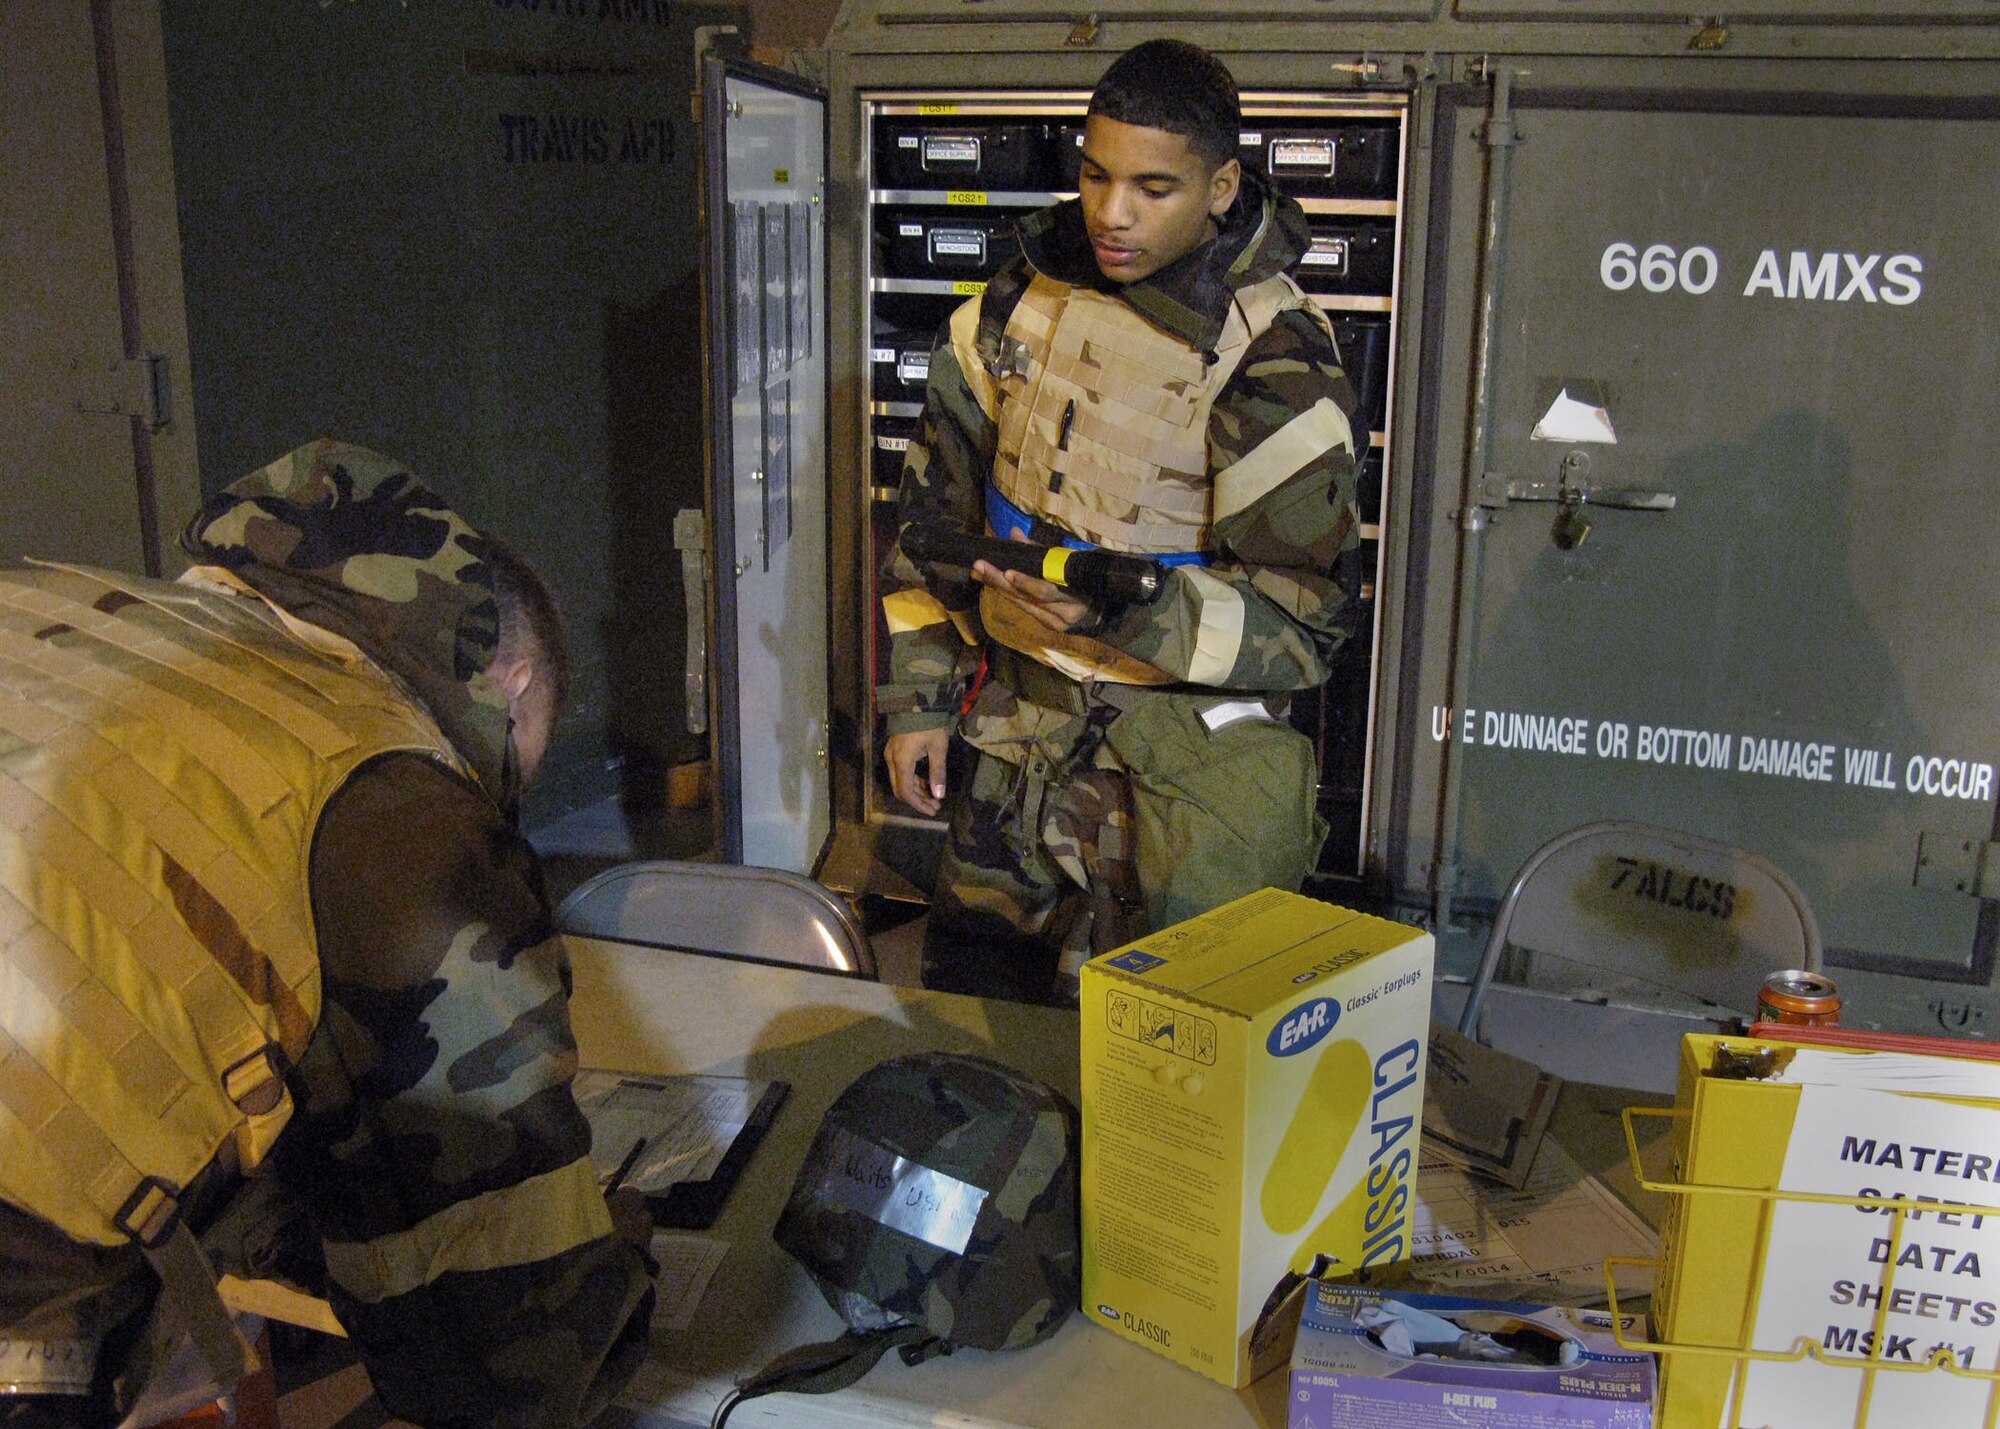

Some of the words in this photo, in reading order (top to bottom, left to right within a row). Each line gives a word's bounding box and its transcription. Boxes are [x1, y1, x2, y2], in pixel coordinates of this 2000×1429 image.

[498, 114, 609, 163] TRAVIS
[620, 117, 675, 164] AFB
[899, 138, 909, 146] BIN
[927, 150, 947, 158] OFFICE
[1275, 154, 1299, 162] OFFICE
[957, 193, 977, 203] CS2
[939, 244, 977, 252] BENCHSTOCK
[1600, 242, 1719, 295] 660
[1743, 249, 1924, 306] AMXS
[963, 284, 983, 293] CS3
[881, 351, 892, 360] #7
[878, 437, 892, 448] BIN
[1484, 711, 1588, 755] DUNNAGE
[1596, 721, 1629, 759] OR
[1637, 726, 1732, 770] BOTTOM
[1738, 736, 1834, 782] DAMAGE
[1844, 748, 1896, 790] WILL
[1906, 756, 1993, 801] OCCUR
[1312, 948, 1370, 973] CLASSIC
[1383, 968, 1422, 996] Earplugs
[1359, 1037, 1420, 1284] CLASSIC
[1498, 1217, 1531, 1229] 015
[1868, 1237, 1982, 1278] DATA
[1317, 1293, 1351, 1306] PLUS
[1829, 1279, 1997, 1327] SHEETS
[1123, 1311, 1172, 1348] CLASSIC
[1823, 1325, 1917, 1361] MSK
[1301, 1356, 1336, 1369] 8005L
[1297, 1375, 1311, 1383] REF
[1312, 1375, 1340, 1388] 8005L
[1559, 1375, 1594, 1389] PLUS
[1597, 1381, 1641, 1393] N-DEX
[1442, 1392, 1471, 1408] N-DEX
[1473, 1395, 1498, 1410] PLUS
